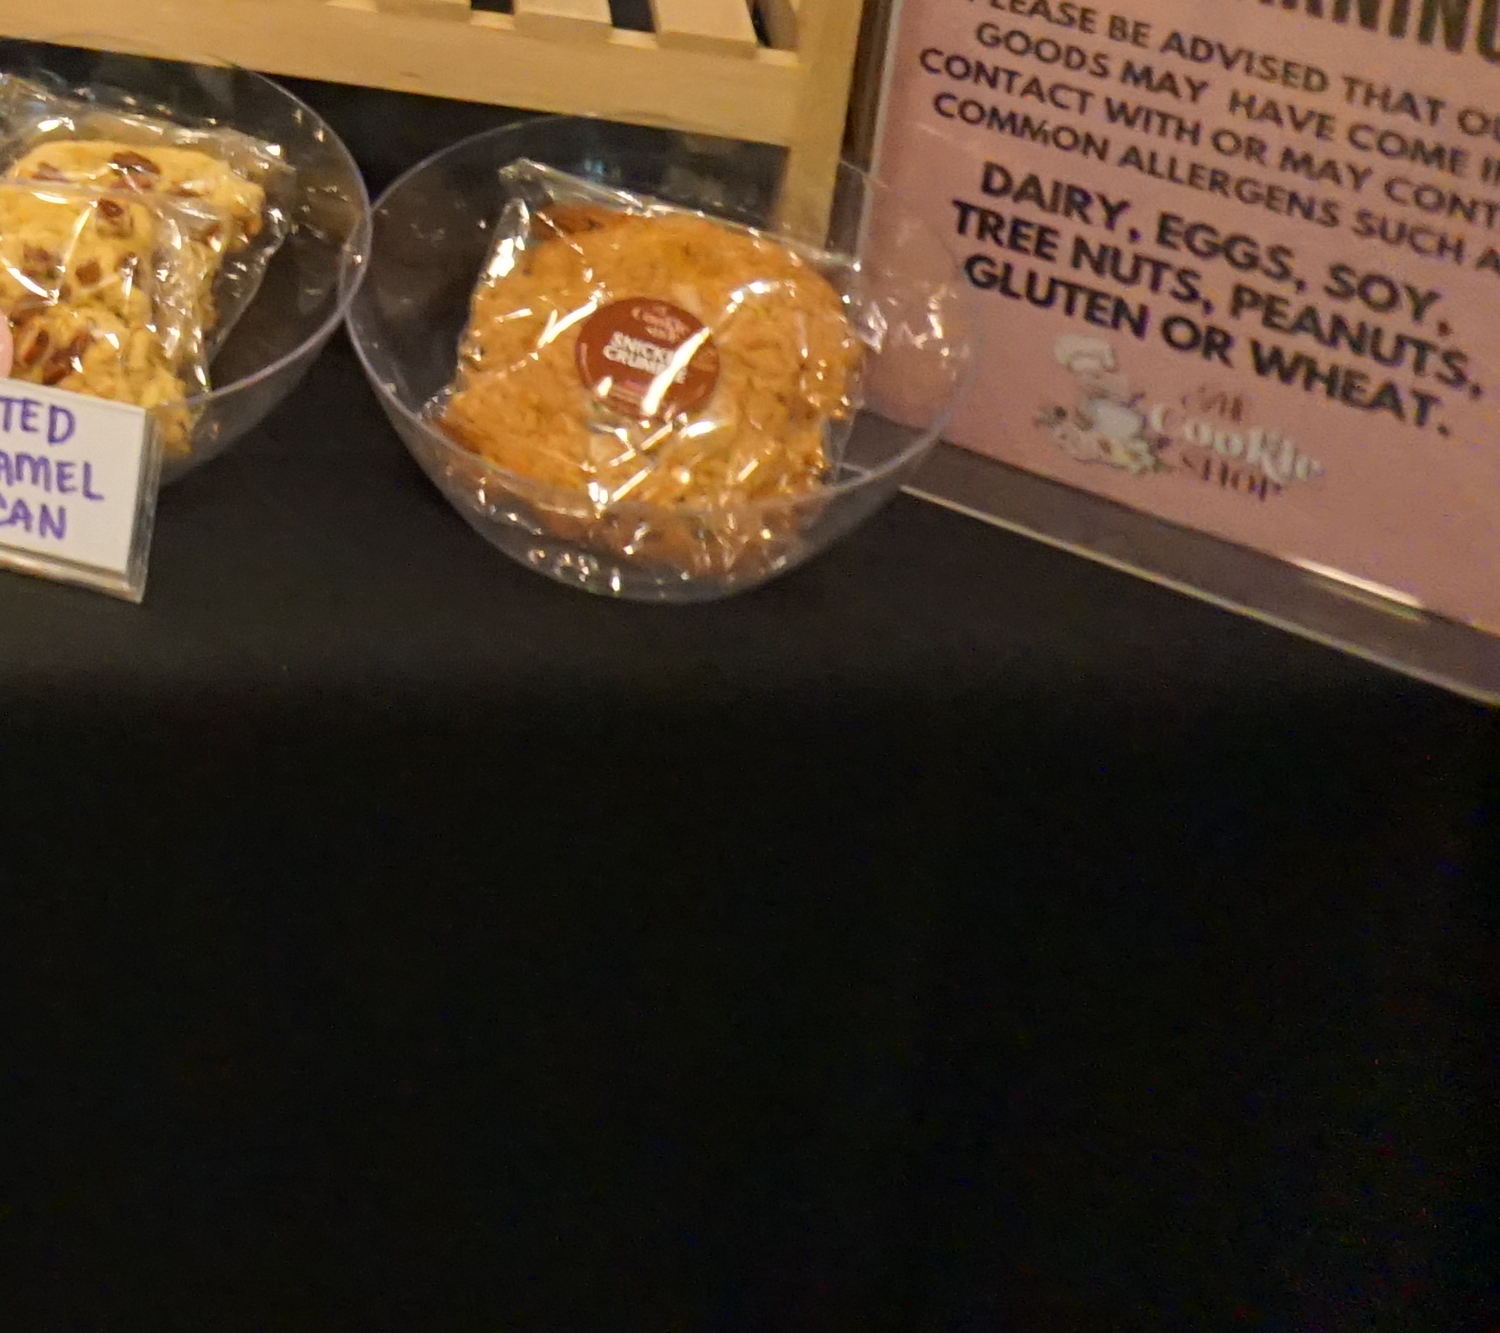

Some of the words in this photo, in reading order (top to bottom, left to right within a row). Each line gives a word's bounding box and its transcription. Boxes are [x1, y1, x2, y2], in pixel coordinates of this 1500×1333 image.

[920, 46, 1094, 116] CONTACT
[1104, 96, 1201, 147] WITH
[1211, 127, 1268, 165] OR
[1280, 149, 1374, 192] MAY
[976, 22, 1110, 80] GOODS
[1121, 60, 1213, 103] MAY
[1228, 89, 1334, 142] HAVE
[1347, 122, 1466, 176] COME
[1108, 12, 1150, 47] BE
[1161, 31, 1329, 95] ADVISED
[1344, 74, 1446, 125] THAT
[933, 91, 1110, 163] COMMON
[1117, 143, 1343, 229] ALLERGENS
[1353, 209, 1467, 267] SUCH
[980, 161, 1143, 244] DAIRY,
[1156, 212, 1306, 292] EGGS,
[952, 199, 1059, 262] TREE
[1072, 237, 1216, 315] NUTS,
[1230, 285, 1485, 399] PEANUTS,
[965, 254, 1148, 340] GLUTEN
[1161, 318, 1233, 366] OR
[1250, 341, 1455, 438] WHEAT.
